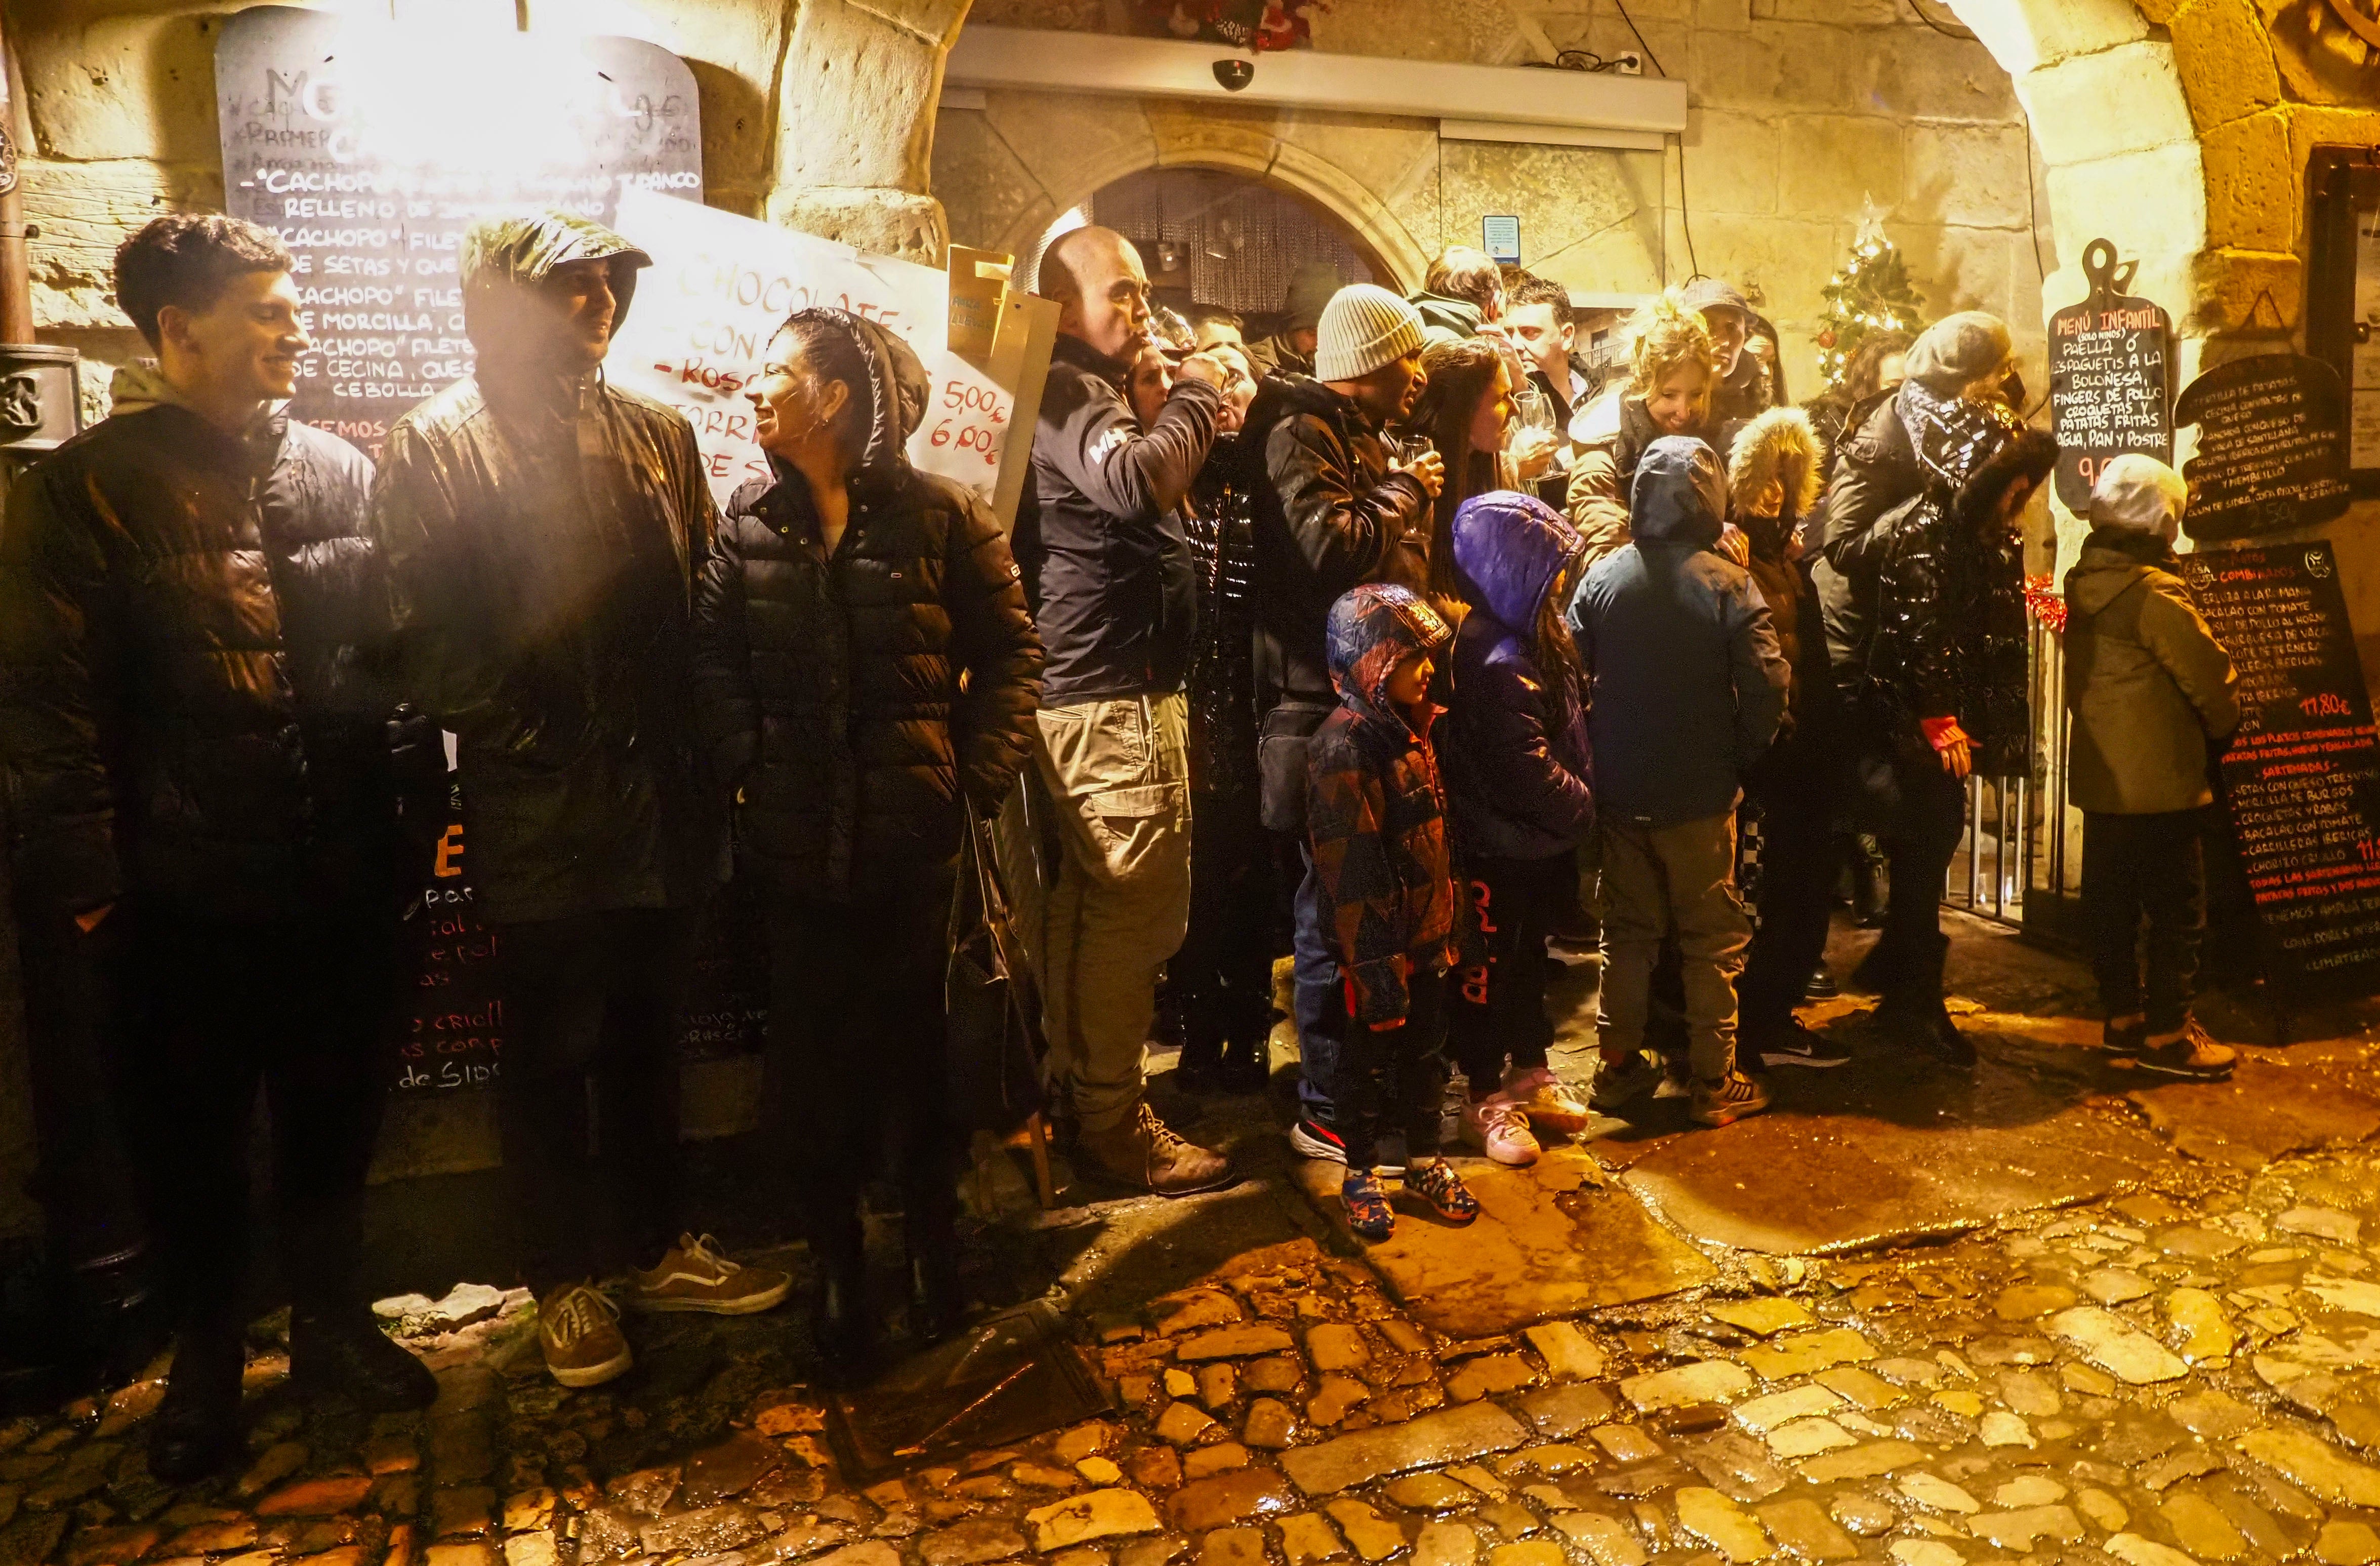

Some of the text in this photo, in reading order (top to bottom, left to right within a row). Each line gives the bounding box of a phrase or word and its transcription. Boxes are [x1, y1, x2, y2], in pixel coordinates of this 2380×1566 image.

[284, 199, 396, 218] RELLENO
[324, 256, 390, 276] SETAS
[397, 258, 410, 274] Y
[322, 313, 442, 334] MORCILLA,
[2057, 310, 2091, 336] MENÚ
[689, 321, 757, 360] CON
[2063, 339, 2114, 356] PAELLA
[326, 359, 416, 381] CECINA,
[2050, 350, 2162, 375] ESPAGUETIS A LA
[333, 382, 436, 397] CEBOLLA
[2053, 386, 2162, 407] FINGERS DE POLLO
[943, 380, 1007, 423] 5,00€
[2066, 401, 2149, 420] CROQUETAS Y
[2060, 412, 2159, 432] PATATAS FRITAS
[930, 418, 1000, 465] 6,00€
[2057, 431, 2087, 450] AGUA,
[2088, 431, 2113, 447] PAN
[2127, 430, 2167, 448] POSTRE
[399, 1066, 430, 1088] de
